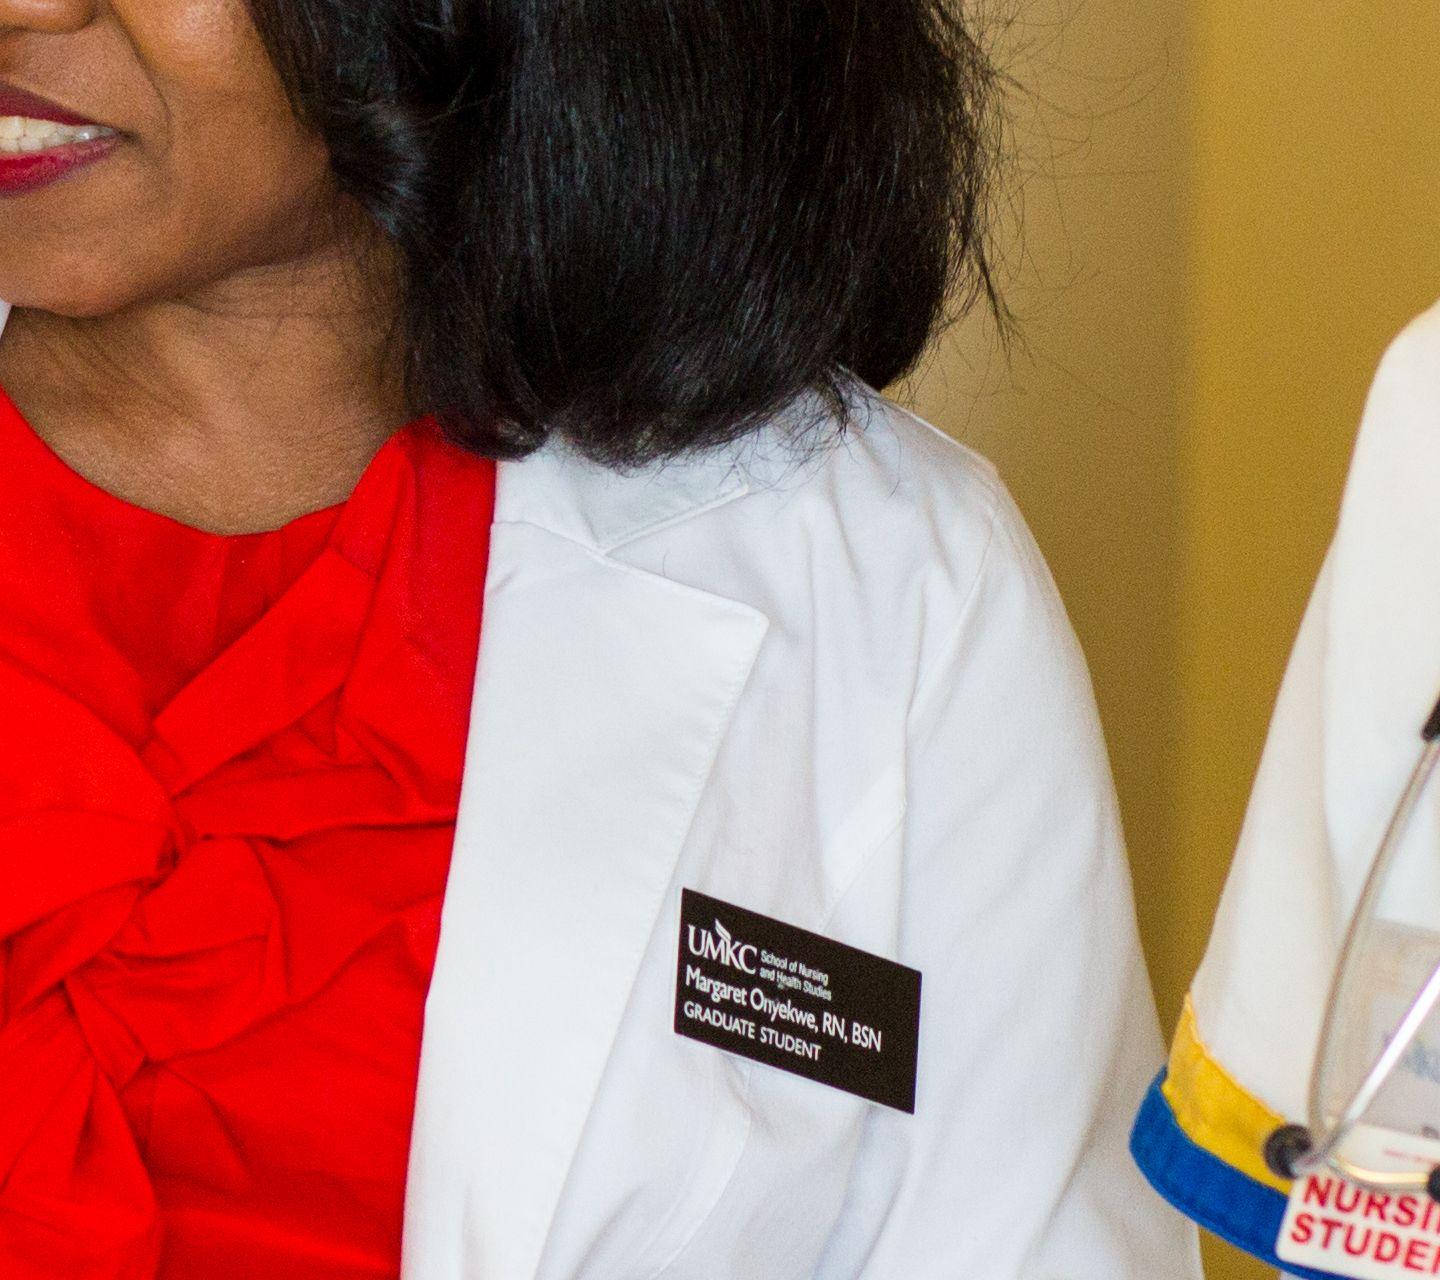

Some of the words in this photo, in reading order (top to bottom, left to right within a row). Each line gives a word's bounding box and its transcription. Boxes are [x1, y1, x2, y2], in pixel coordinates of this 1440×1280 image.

[687, 918, 758, 975] UMKC
[760, 949, 788, 970] School
[789, 961, 798, 973] of
[799, 963, 829, 987] Nursing
[685, 964, 748, 1007] Margaret
[750, 987, 819, 1034] Onyekwe,
[822, 1011, 848, 1044] RN,
[852, 1022, 882, 1053] BSN
[760, 967, 775, 982] and
[803, 980, 832, 1001] Studies
[683, 1000, 756, 1040] GRADUATE
[760, 1026, 822, 1061] STUDENT
